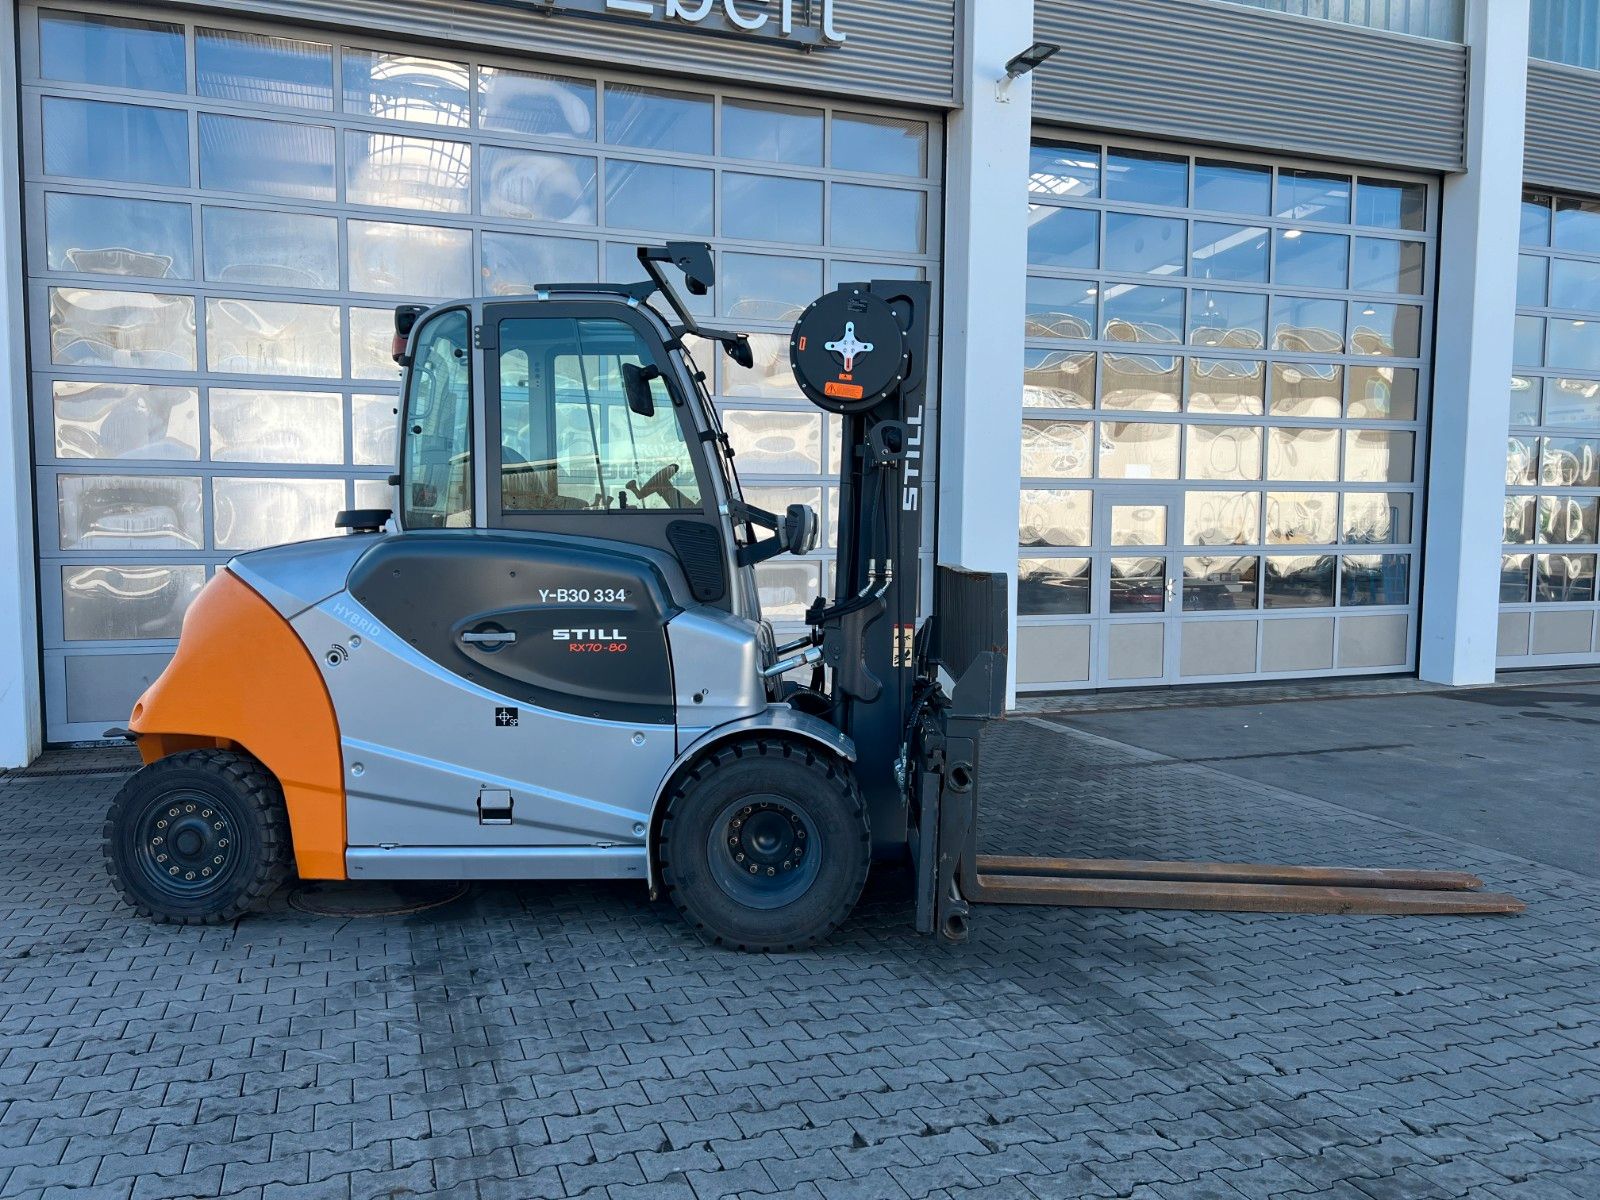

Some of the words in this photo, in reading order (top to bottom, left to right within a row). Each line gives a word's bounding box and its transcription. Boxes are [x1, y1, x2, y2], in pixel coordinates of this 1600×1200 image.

[902, 404, 923, 511] STILL
[538, 588, 590, 603] Y-B30
[593, 588, 626, 603] 334
[333, 602, 380, 636] HYBRID
[552, 628, 627, 640] STILL
[568, 643, 628, 653] RX70-80
